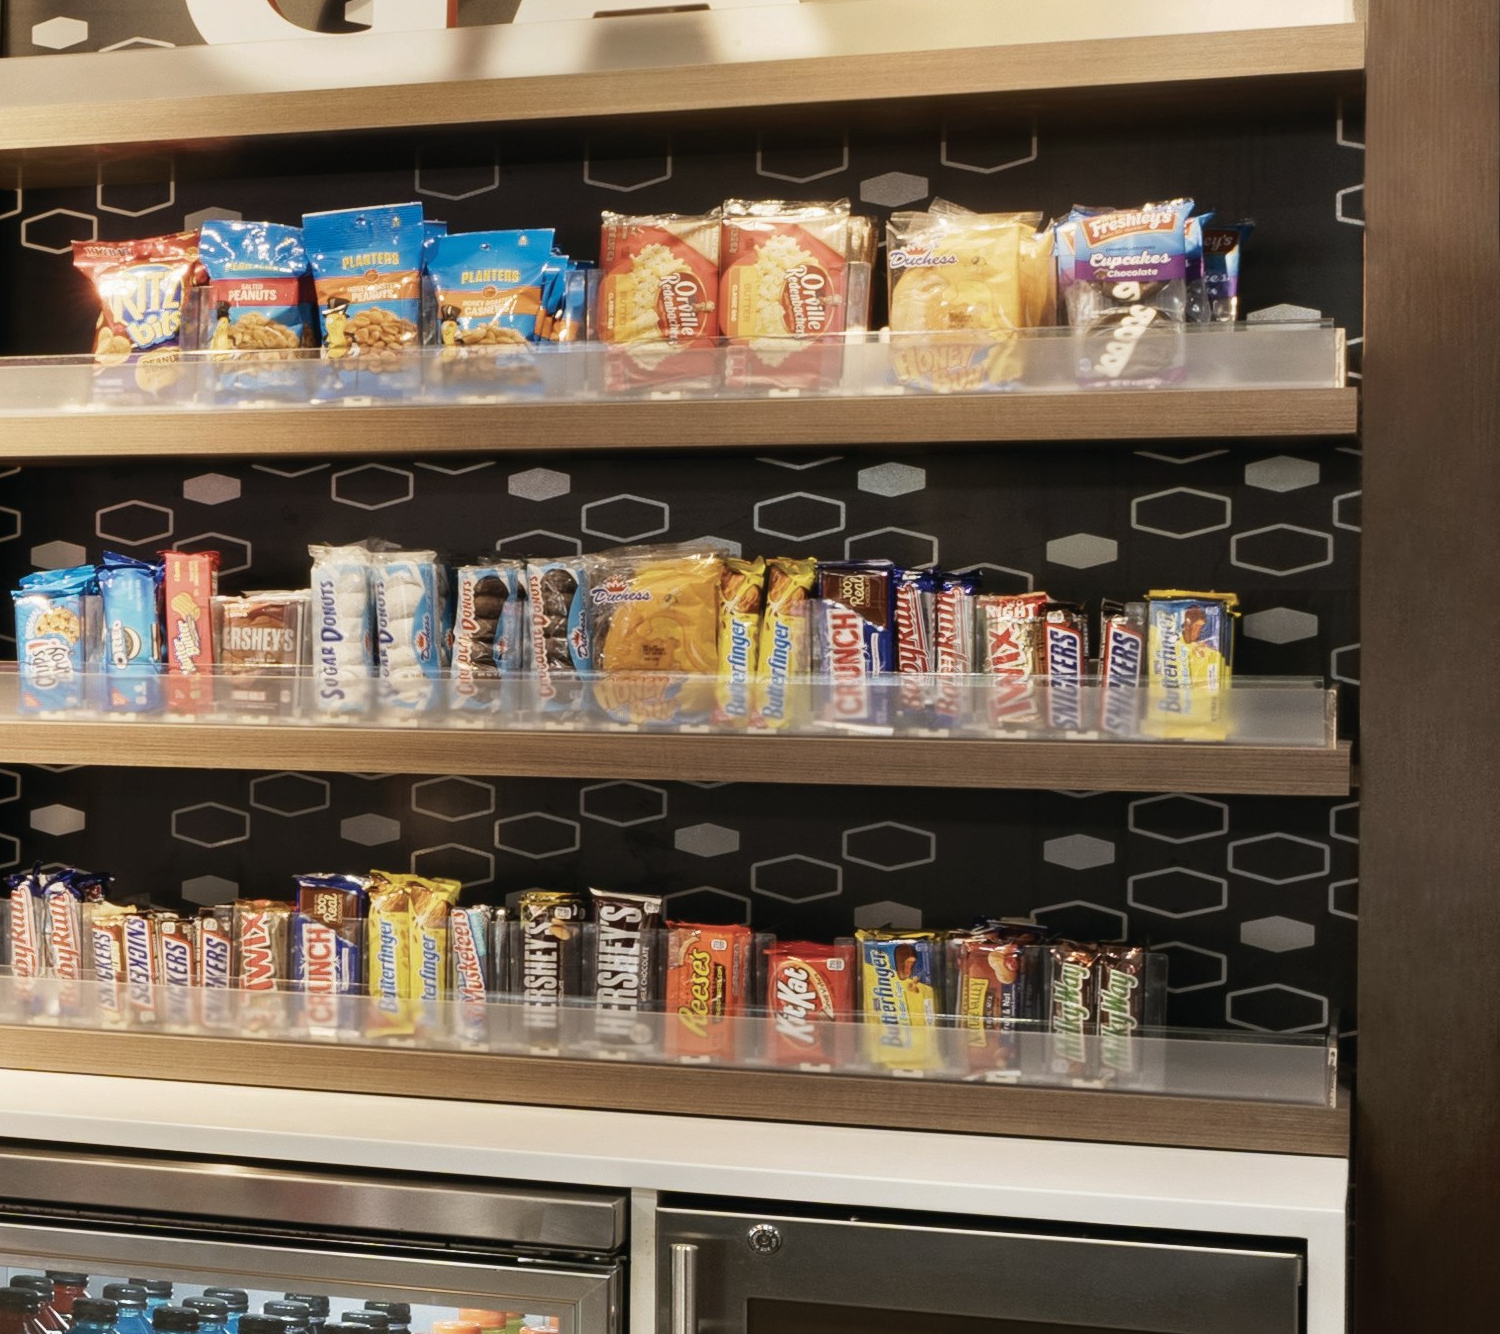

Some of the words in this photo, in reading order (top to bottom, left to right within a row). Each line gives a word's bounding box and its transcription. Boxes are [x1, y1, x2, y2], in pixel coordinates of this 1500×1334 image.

[1089, 210, 1175, 235] Freshley's
[342, 251, 399, 270] PLANTERS
[461, 269, 520, 284] PLANTERS
[889, 250, 958, 269] Duchess
[1089, 252, 1171, 268] Cupcakes
[1106, 267, 1158, 279] Chocolate
[228, 288, 277, 302] PEANUTS
[351, 289, 399, 302] PEANUTS
[675, 280, 698, 336] Orville
[801, 273, 826, 331] Orville
[321, 580, 344, 644] DONUTS
[461, 579, 480, 633] DONUTS
[529, 575, 550, 628] DONUTS
[590, 585, 652, 604] Duchess
[850, 574, 866, 607] Real
[985, 604, 1035, 618] RIGHT
[222, 626, 294, 652] ERSHEY'S
[421, 615, 435, 661] Duchess
[577, 610, 589, 659] Duchess
[321, 646, 345, 700] SUGAR
[726, 619, 751, 717] Butterfinger
[761, 621, 790, 719] Butterfinger
[832, 612, 865, 717] CRUNCH
[988, 627, 1037, 724] TWIX
[1049, 630, 1080, 727] SNICKERS
[1105, 632, 1139, 733] SNICKERS
[323, 892, 338, 923] Real
[125, 919, 151, 1004] SNICKERS
[165, 940, 190, 1015] NICKERS
[240, 913, 275, 995] TWIX
[306, 928, 334, 1022] CRUNCH
[378, 918, 399, 1013] Butterfinger
[452, 910, 486, 1005] Musketeers
[523, 922, 558, 1028] HERSHEY'S
[594, 905, 643, 1035] HERSHEY'S
[641, 946, 650, 986] CHOCOLATE
[677, 948, 712, 1037] Reese's
[969, 979, 986, 1010] VALLEY
[1002, 992, 1011, 1007] Nut
